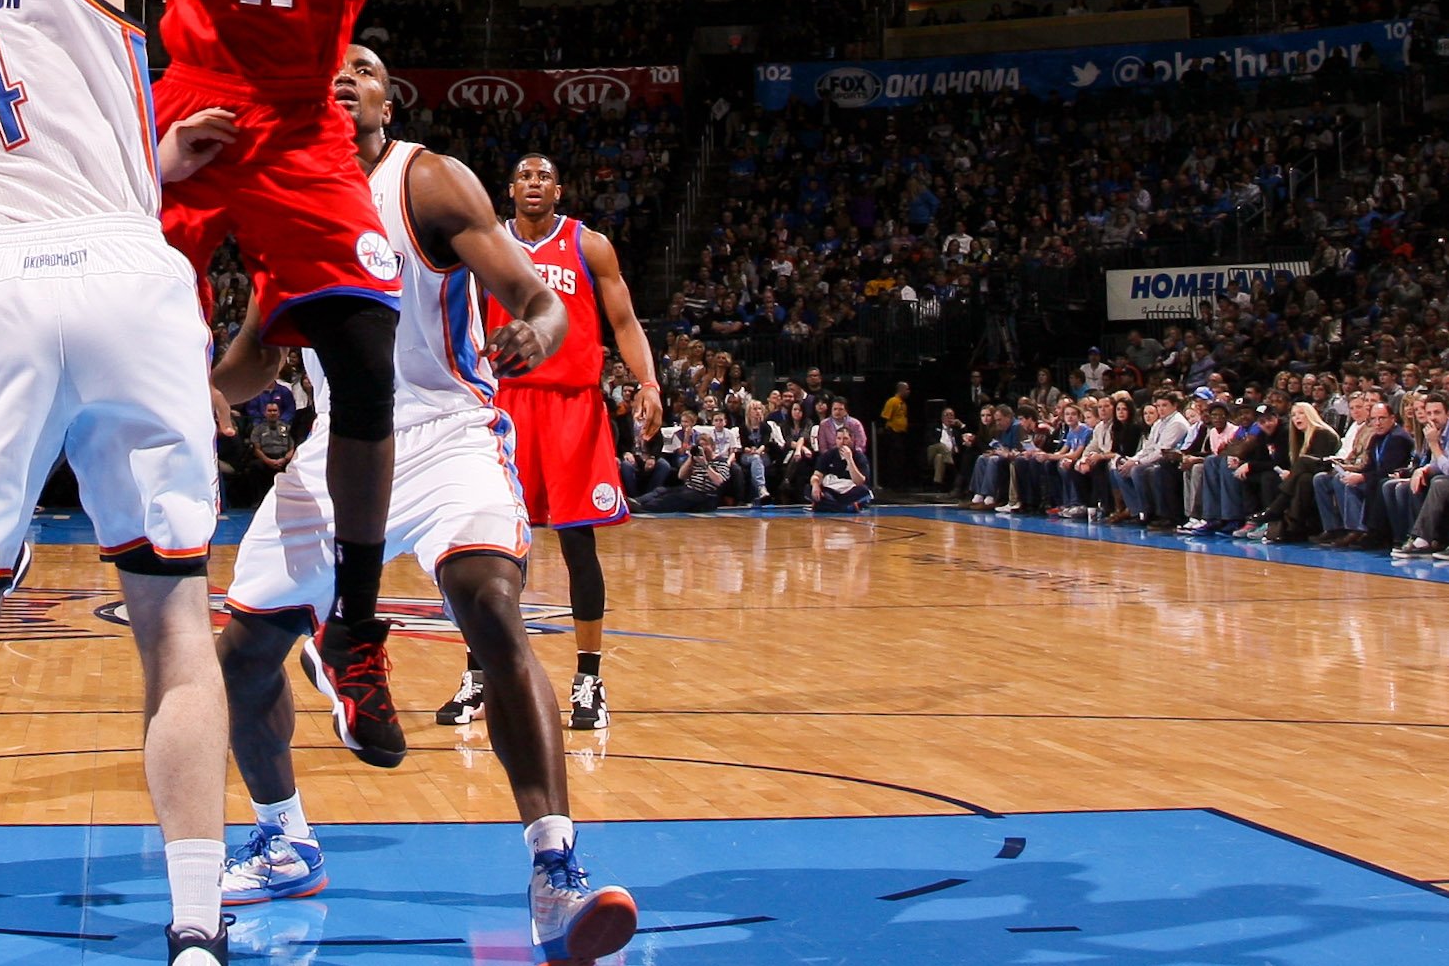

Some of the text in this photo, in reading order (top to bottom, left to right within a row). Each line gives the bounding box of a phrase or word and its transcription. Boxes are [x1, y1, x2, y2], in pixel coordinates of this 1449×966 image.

[1384, 21, 1414, 40] 10
[650, 68, 679, 83] 101
[756, 65, 792, 81] 102
[830, 76, 867, 92] FOX
[461, 83, 510, 106] KIA
